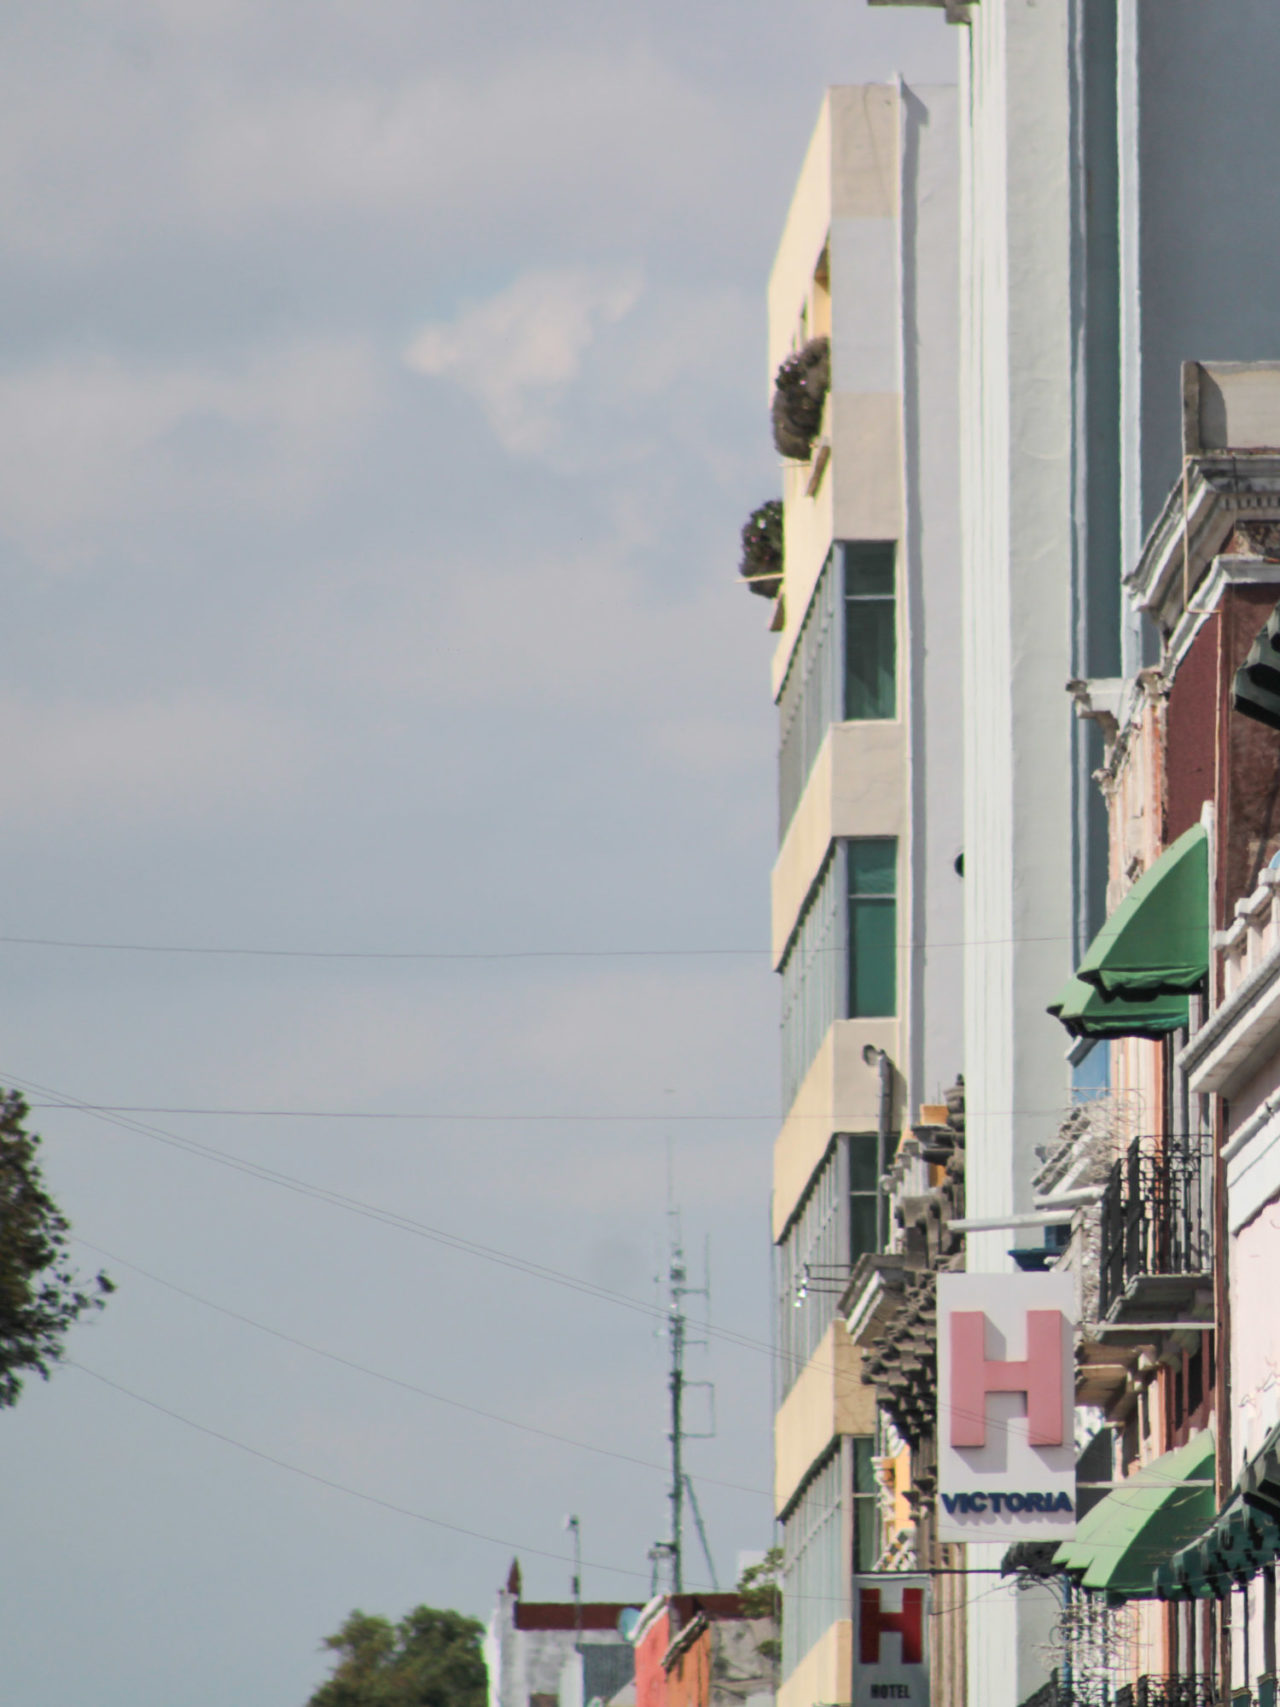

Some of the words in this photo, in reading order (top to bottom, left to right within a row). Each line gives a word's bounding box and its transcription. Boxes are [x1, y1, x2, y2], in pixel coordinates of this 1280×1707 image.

[950, 1310, 1063, 1447] H
[941, 1491, 1073, 1514] VICTORIA
[859, 1587, 923, 1664] H
[870, 1684, 909, 1699] HOTEL
